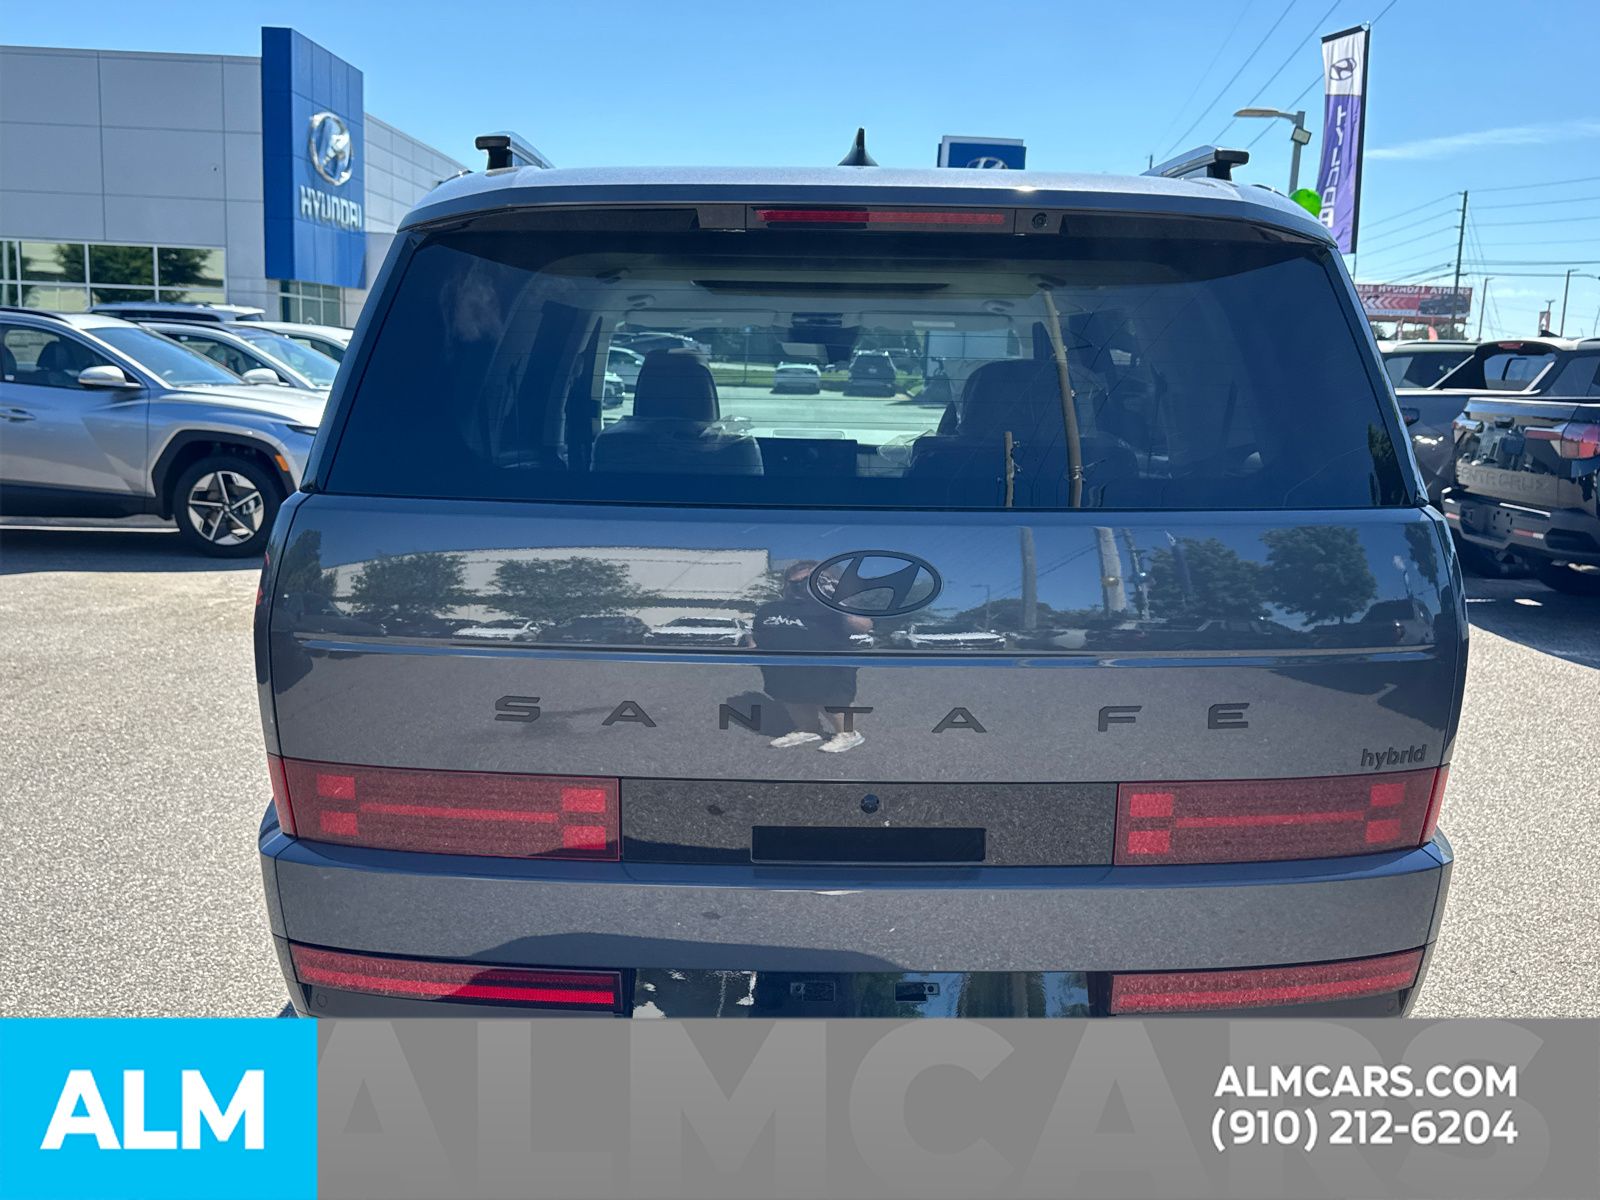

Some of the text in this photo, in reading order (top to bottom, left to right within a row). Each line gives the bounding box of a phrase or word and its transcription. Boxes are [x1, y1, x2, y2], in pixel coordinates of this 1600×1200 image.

[300, 184, 362, 228] HYUNDAI
[1378, 285, 1425, 294] HYUNDAI
[495, 695, 1250, 734] SANTA FE
[1361, 744, 1427, 770] hybrid
